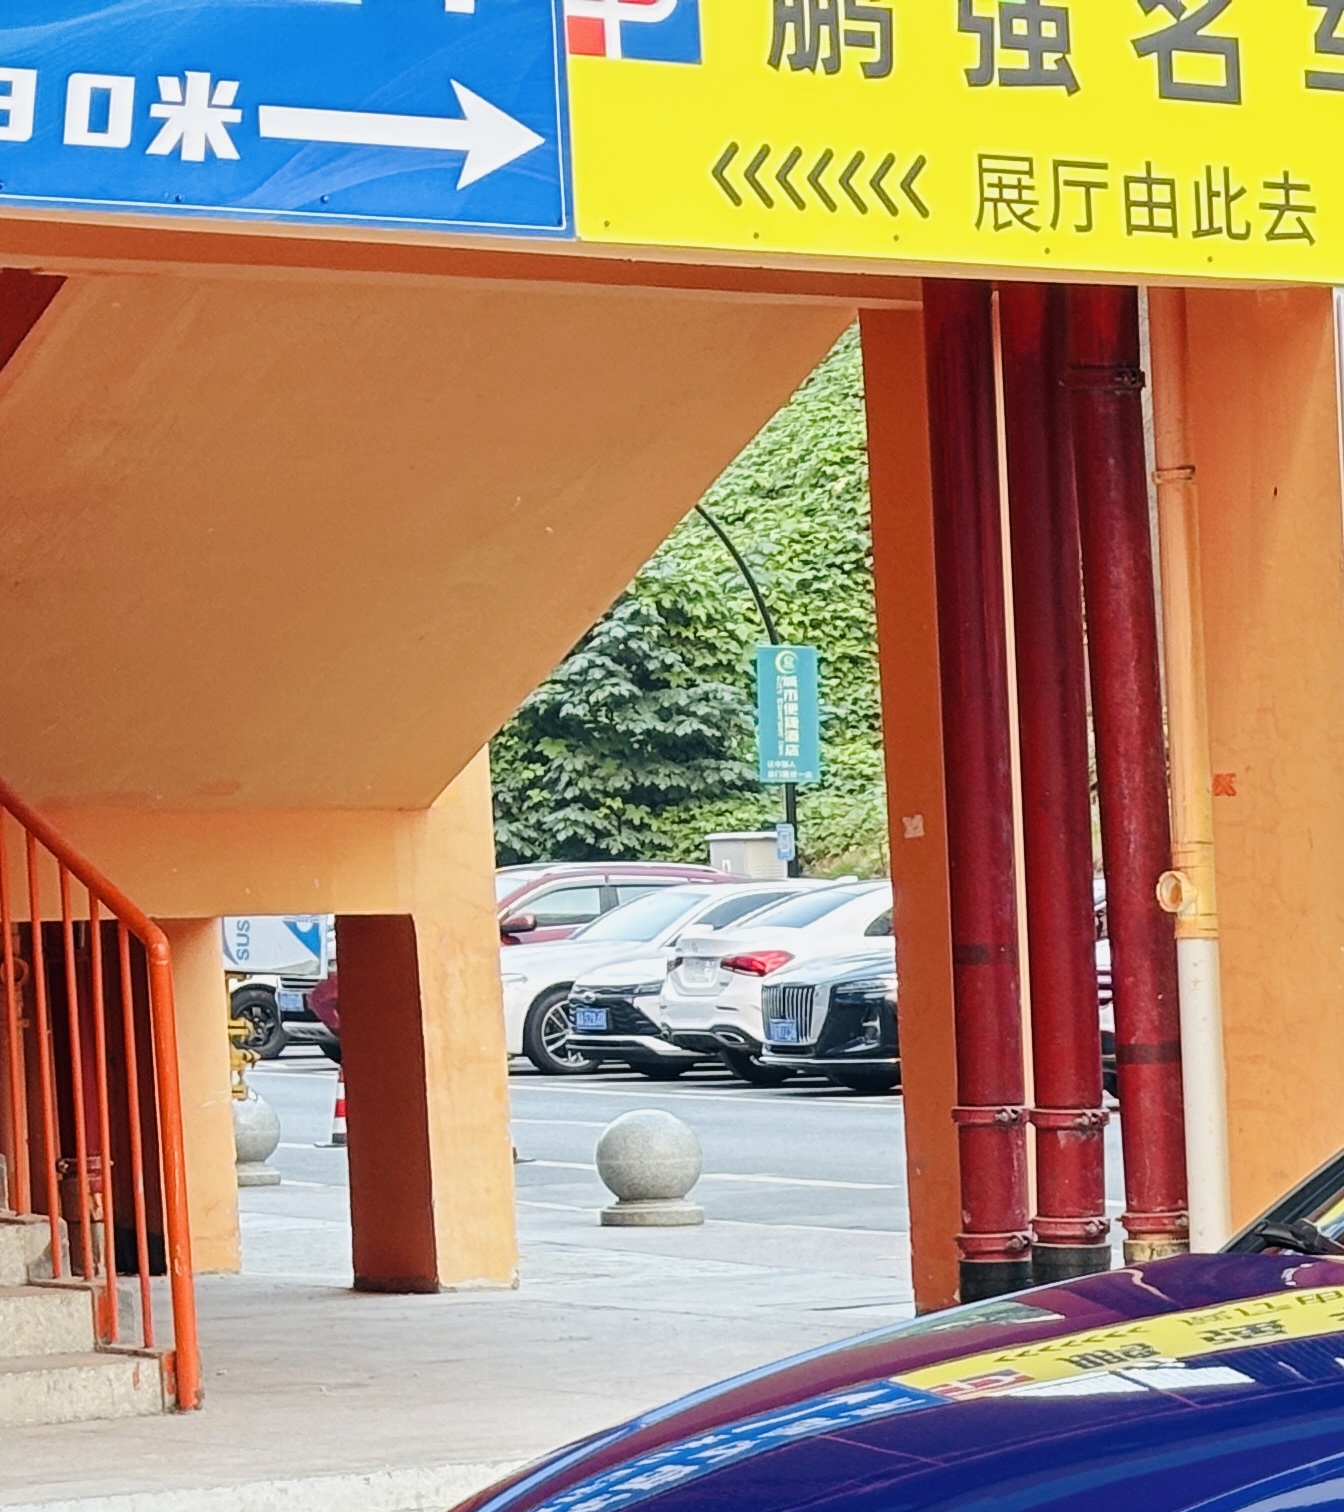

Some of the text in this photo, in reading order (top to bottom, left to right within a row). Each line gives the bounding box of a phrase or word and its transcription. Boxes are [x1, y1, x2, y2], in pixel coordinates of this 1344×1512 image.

[974, 153, 1318, 247] 展厅由此去
